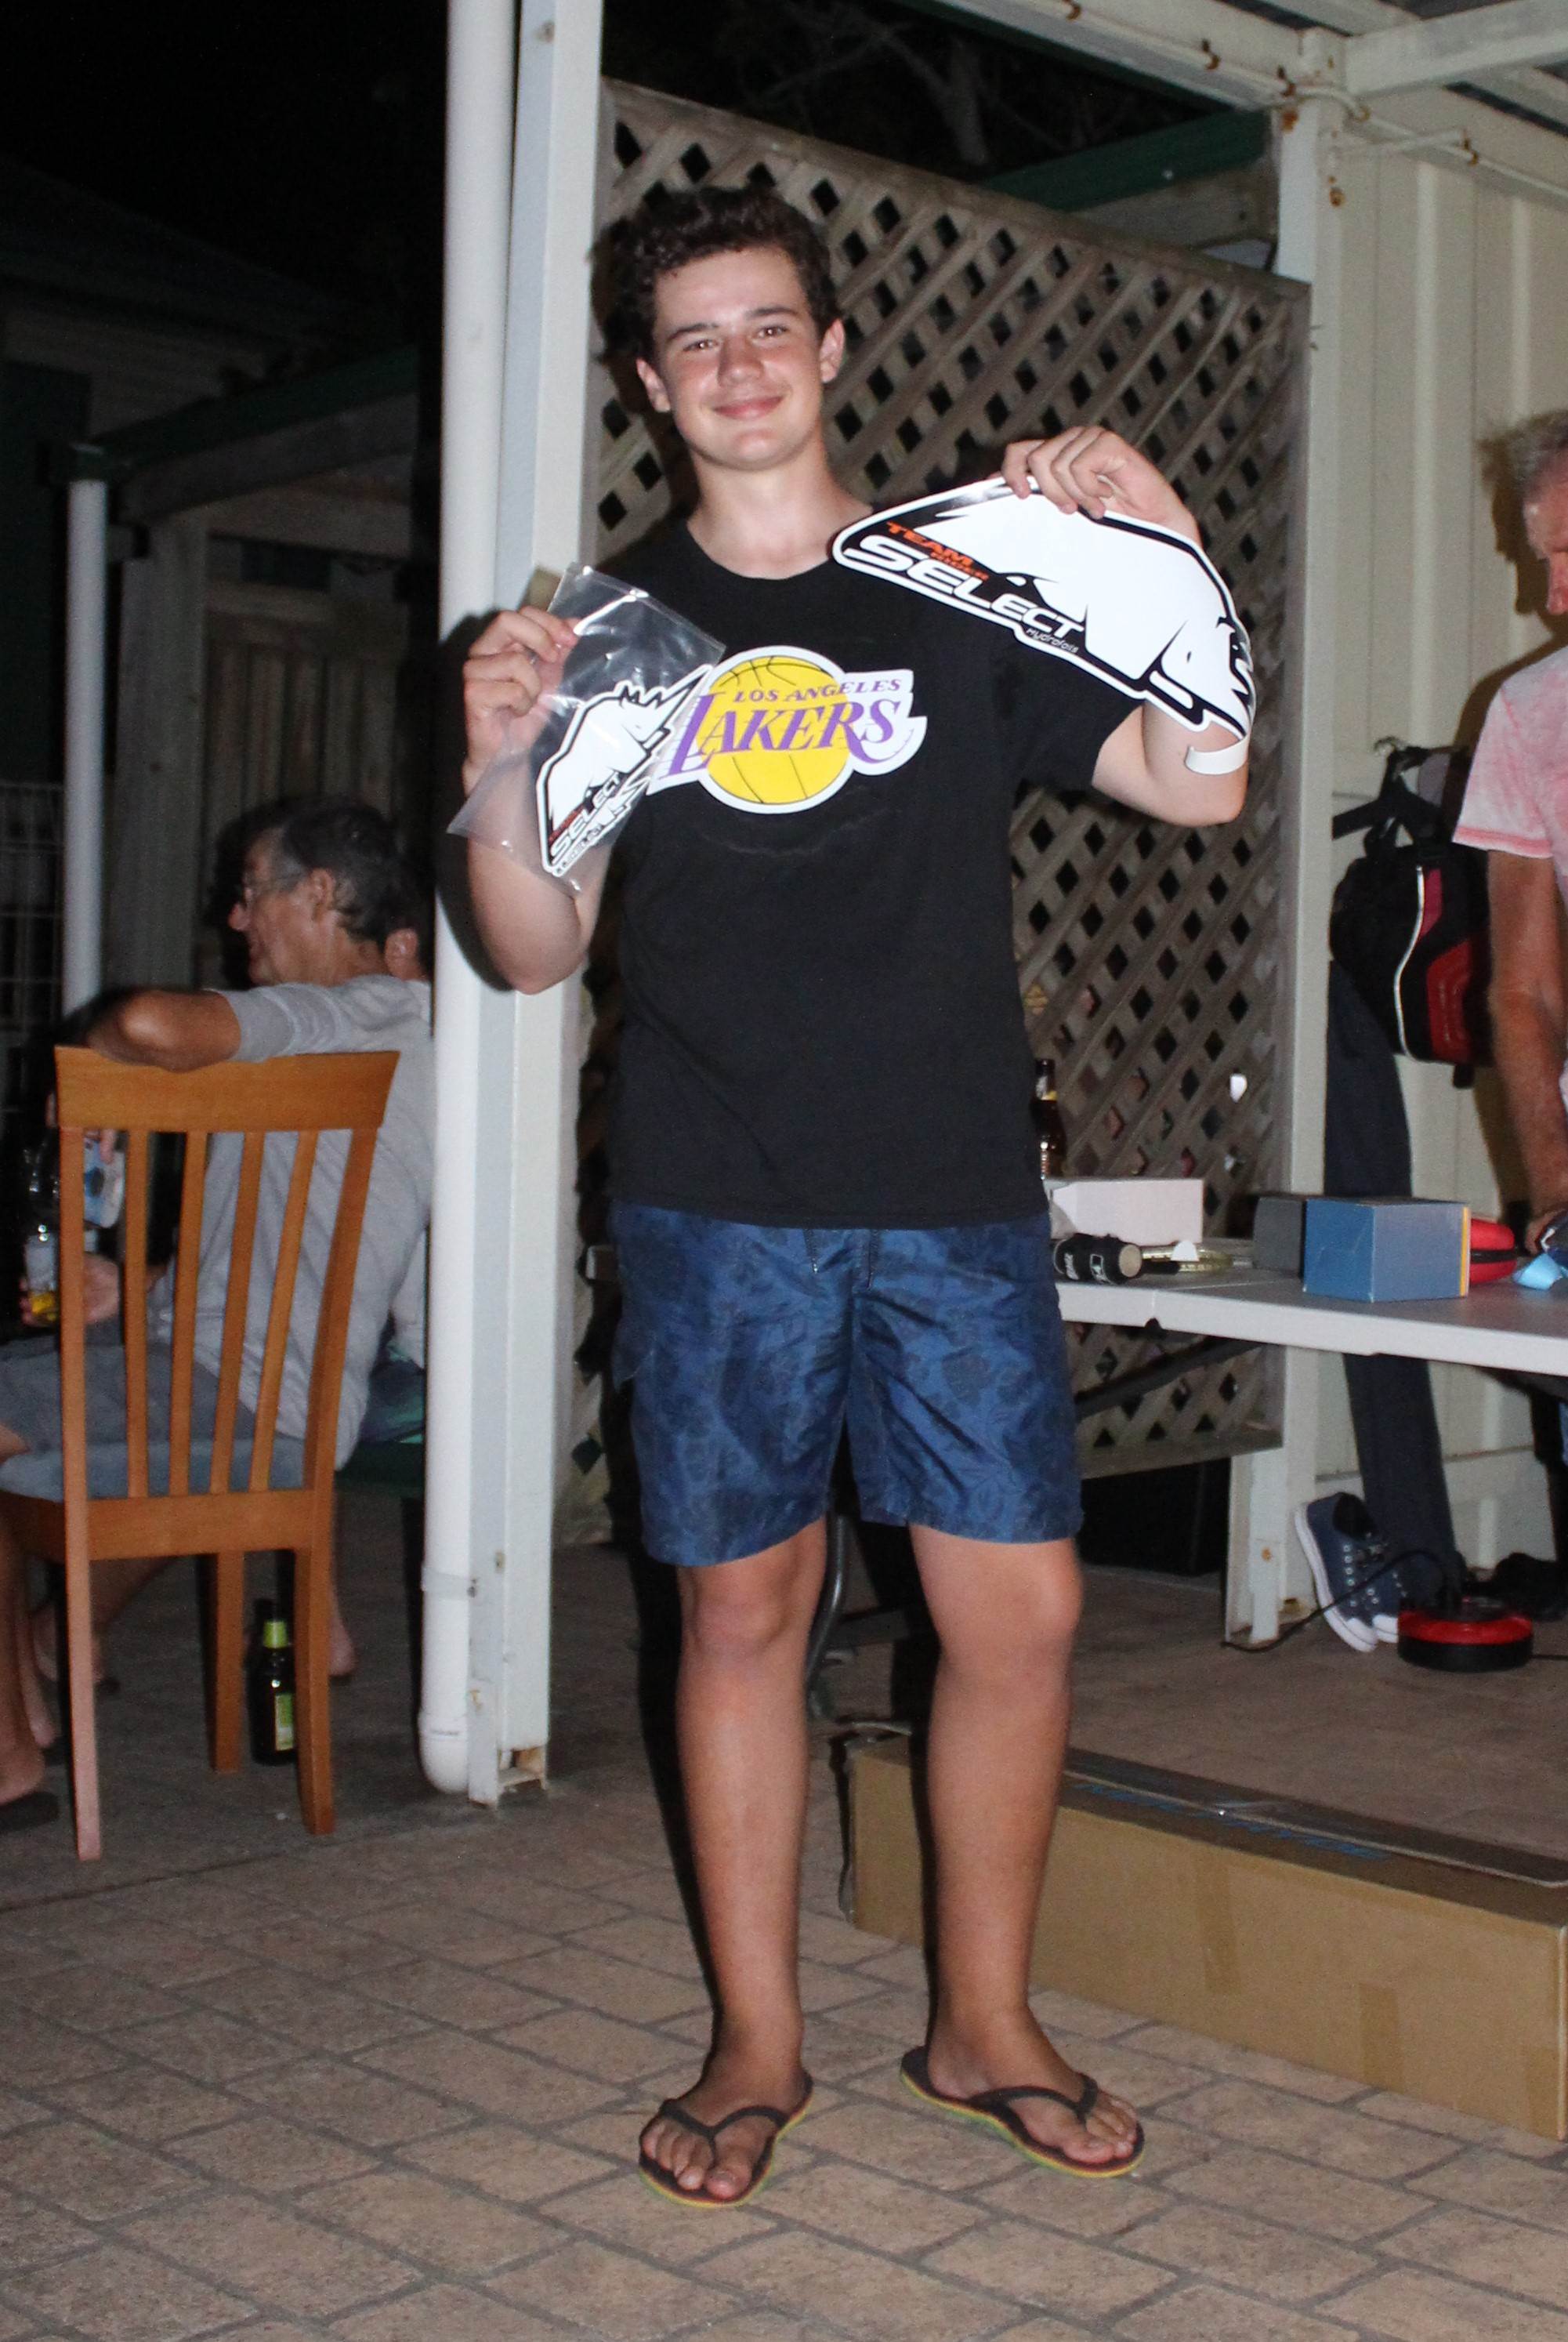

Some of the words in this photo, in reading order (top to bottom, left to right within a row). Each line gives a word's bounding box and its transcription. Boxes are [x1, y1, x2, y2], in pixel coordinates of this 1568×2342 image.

[843, 535, 1085, 639] SELECT
[886, 521, 973, 567] TEAM
[658, 691, 914, 780] LAKERS
[733, 689, 779, 703] LOS
[784, 679, 902, 702] ANGELES
[551, 771, 621, 865] SELECT
